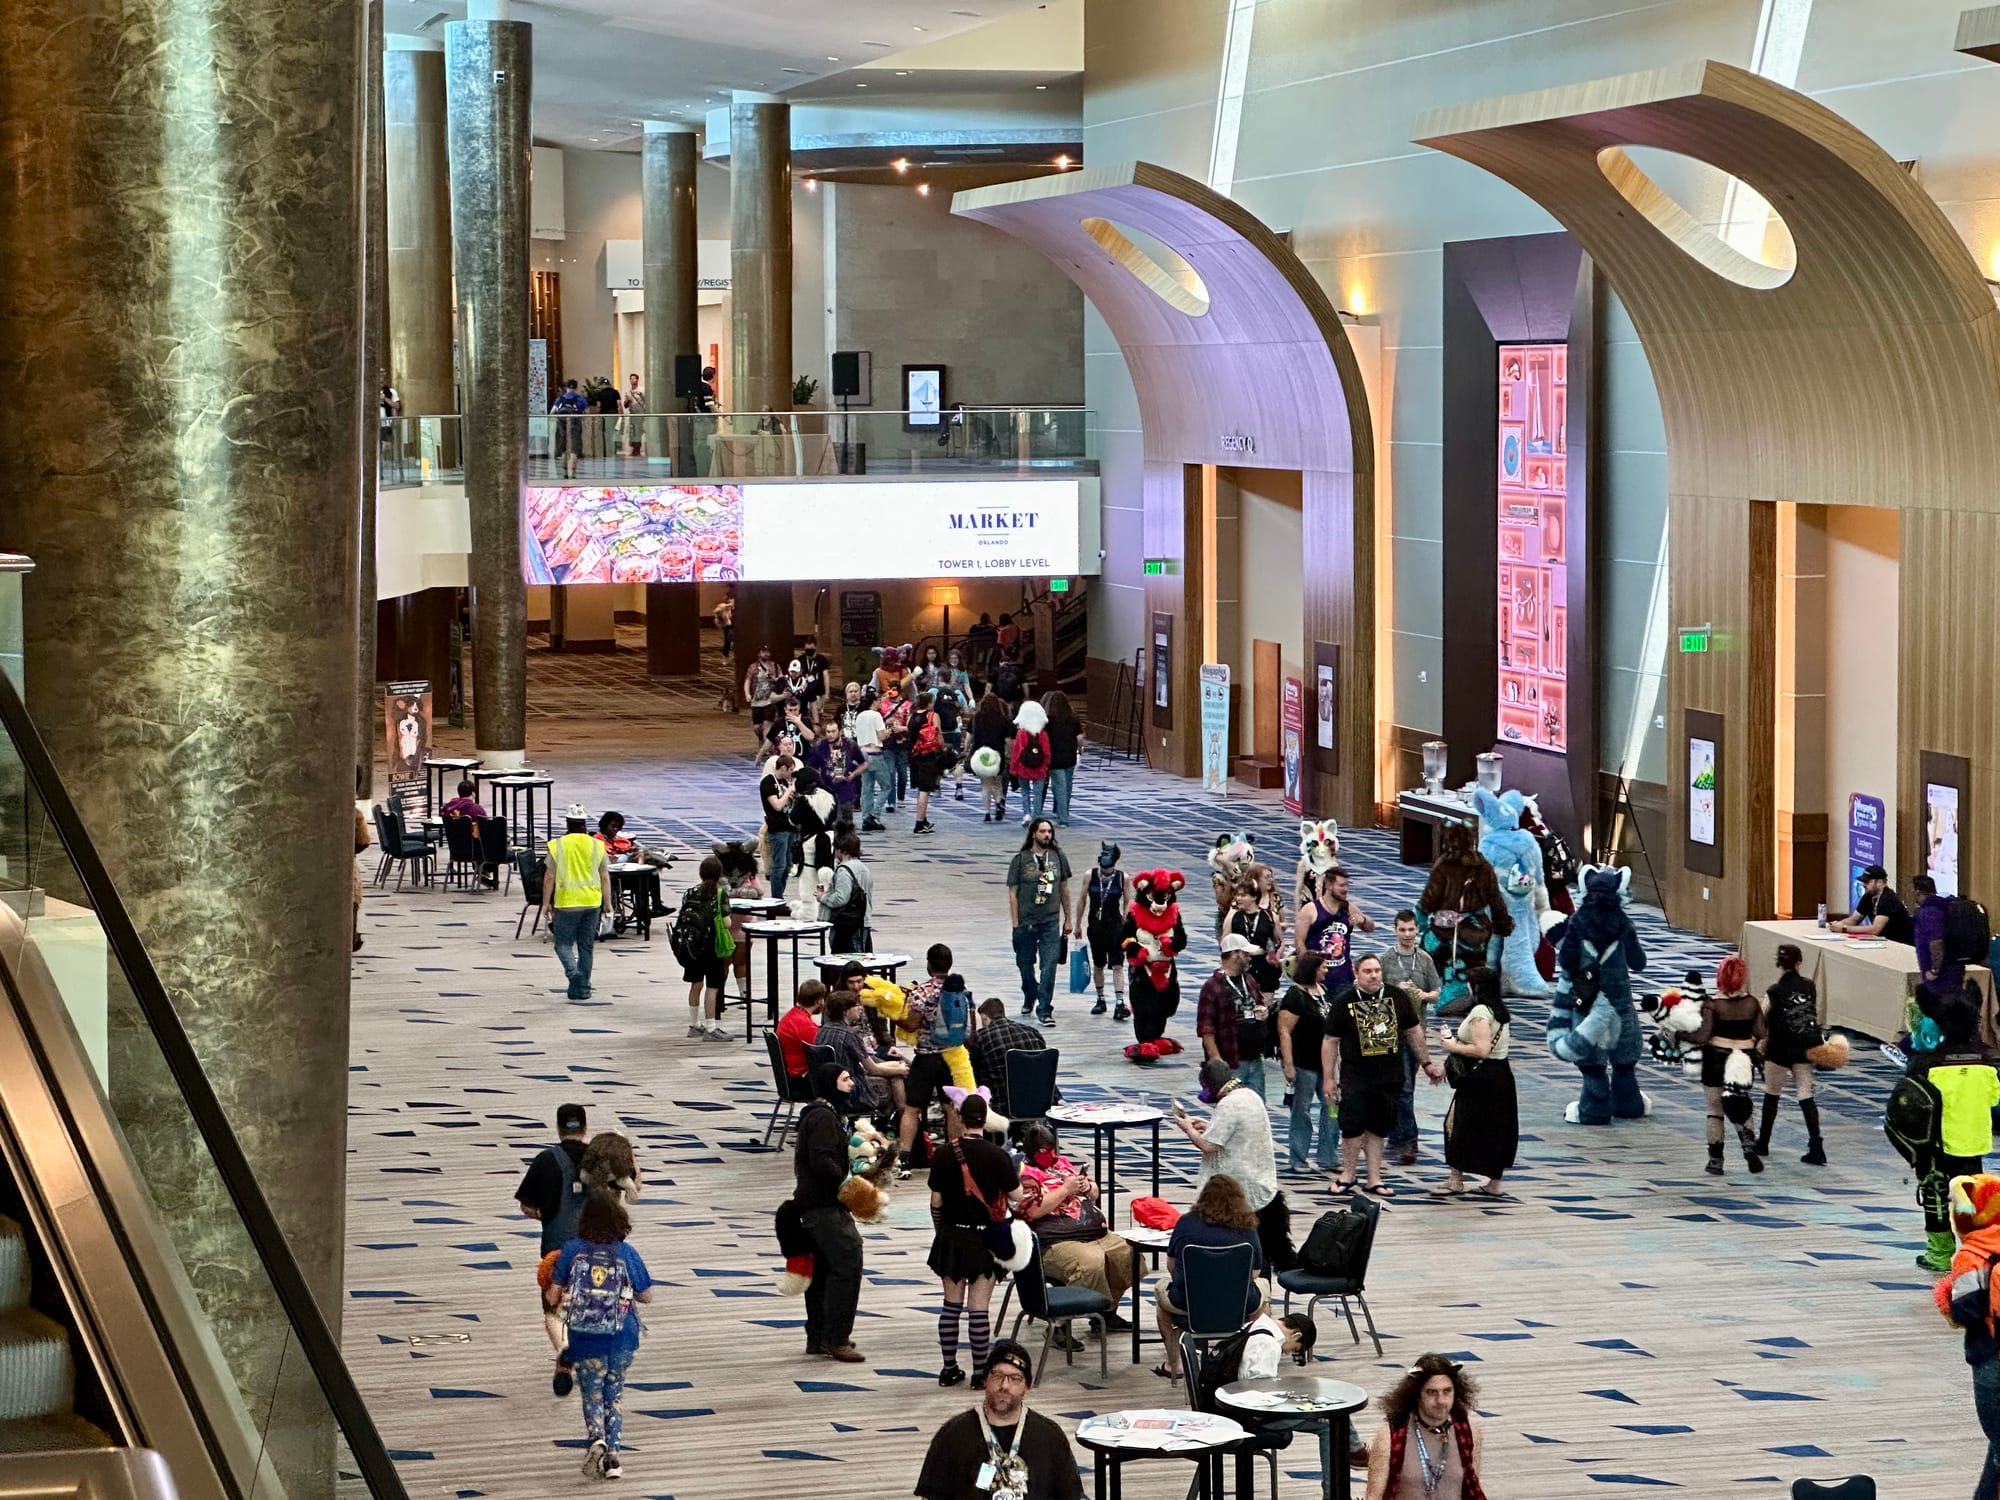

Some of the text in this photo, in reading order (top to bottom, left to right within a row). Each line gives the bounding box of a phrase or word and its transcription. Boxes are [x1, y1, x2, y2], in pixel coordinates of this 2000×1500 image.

[627, 278, 640, 287] TO
[949, 512, 1039, 529] MARKET
[938, 558, 1050, 570] TOWER 1, LOBBY LEVEL
[1146, 562, 1161, 575] EXIT
[1682, 633, 1705, 652] EXIT
